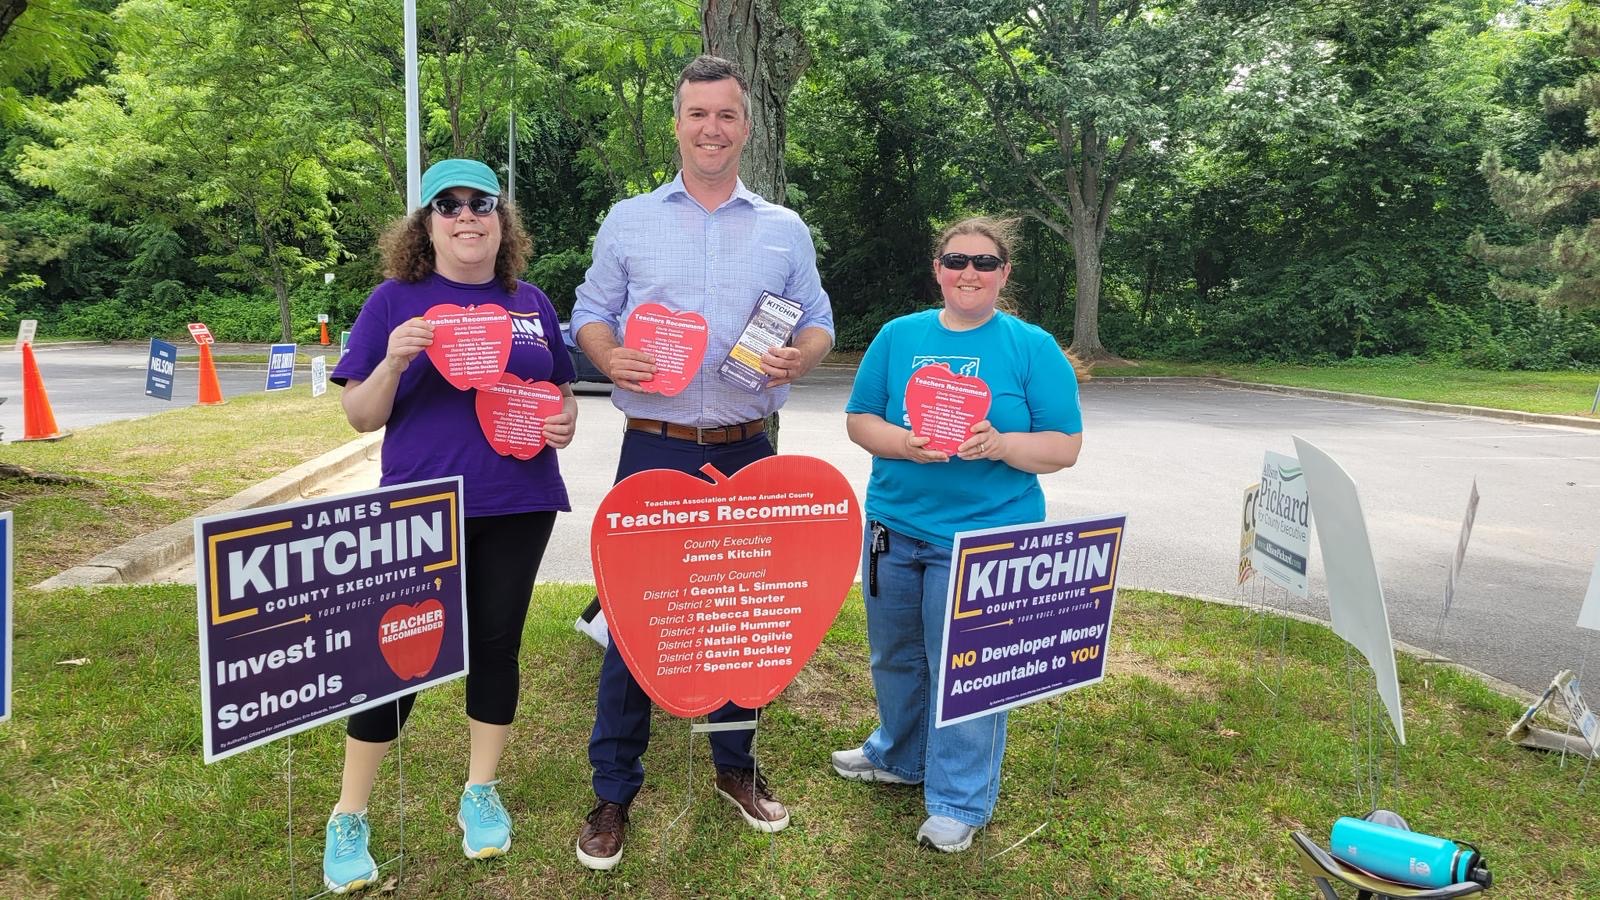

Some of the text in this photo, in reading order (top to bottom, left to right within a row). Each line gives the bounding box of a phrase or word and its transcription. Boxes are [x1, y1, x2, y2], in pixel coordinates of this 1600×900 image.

[766, 300, 798, 319] KITCHIN
[635, 314, 664, 324] Teachers
[666, 320, 705, 330] Recommend
[151, 357, 174, 376] NELSON
[519, 390, 560, 400] Recommend
[915, 377, 944, 388] Teachers
[947, 384, 987, 396] Recommend
[1259, 477, 1309, 528] Pickard
[302, 501, 382, 530] JAMES
[606, 500, 848, 529] Teachers Recommend
[1265, 514, 1280, 532] County
[1280, 520, 1306, 542] Executive
[684, 535, 772, 550] County Executive
[1019, 532, 1074, 550] JAMES
[228, 511, 443, 600] KITCHIN
[683, 548, 772, 563] James Kitchin
[689, 569, 766, 584] County Council
[967, 543, 1110, 601] KITCHIN
[265, 566, 416, 613] COUNTY EXECUTIVE
[318, 582, 432, 618] YOUR VOICE, OUR FUTURE
[644, 590, 680, 601] District
[691, 584, 734, 597] Geonta
[739, 584, 750, 592] L.
[753, 579, 808, 591] Simmons
[667, 594, 785, 611] District 2 Will Shorter
[987, 588, 1086, 615] COUNTY EXECUTIVE
[1017, 615, 1033, 624] YOUR
[1058, 607, 1070, 616] OUR
[1071, 601, 1092, 612] FUTURE
[381, 609, 443, 635] TEACHER
[649, 606, 802, 626] District 3 Rebecca Baucom
[382, 620, 444, 644] RECOMMENDED
[660, 628, 696, 638] District
[707, 622, 736, 634] Julie
[740, 620, 791, 631] Hummer
[658, 632, 792, 650] District 5 Natalie Ogilvie
[951, 623, 1105, 670] NO Developer Money
[217, 629, 351, 686] Invest in
[659, 645, 791, 663] District 6 Gavin Buckley
[657, 657, 792, 676] District 7 Spencer Jones
[950, 660, 1048, 696] Accountable
[1052, 655, 1066, 669] to
[1070, 644, 1100, 664] YOU
[217, 673, 343, 730] Schools
